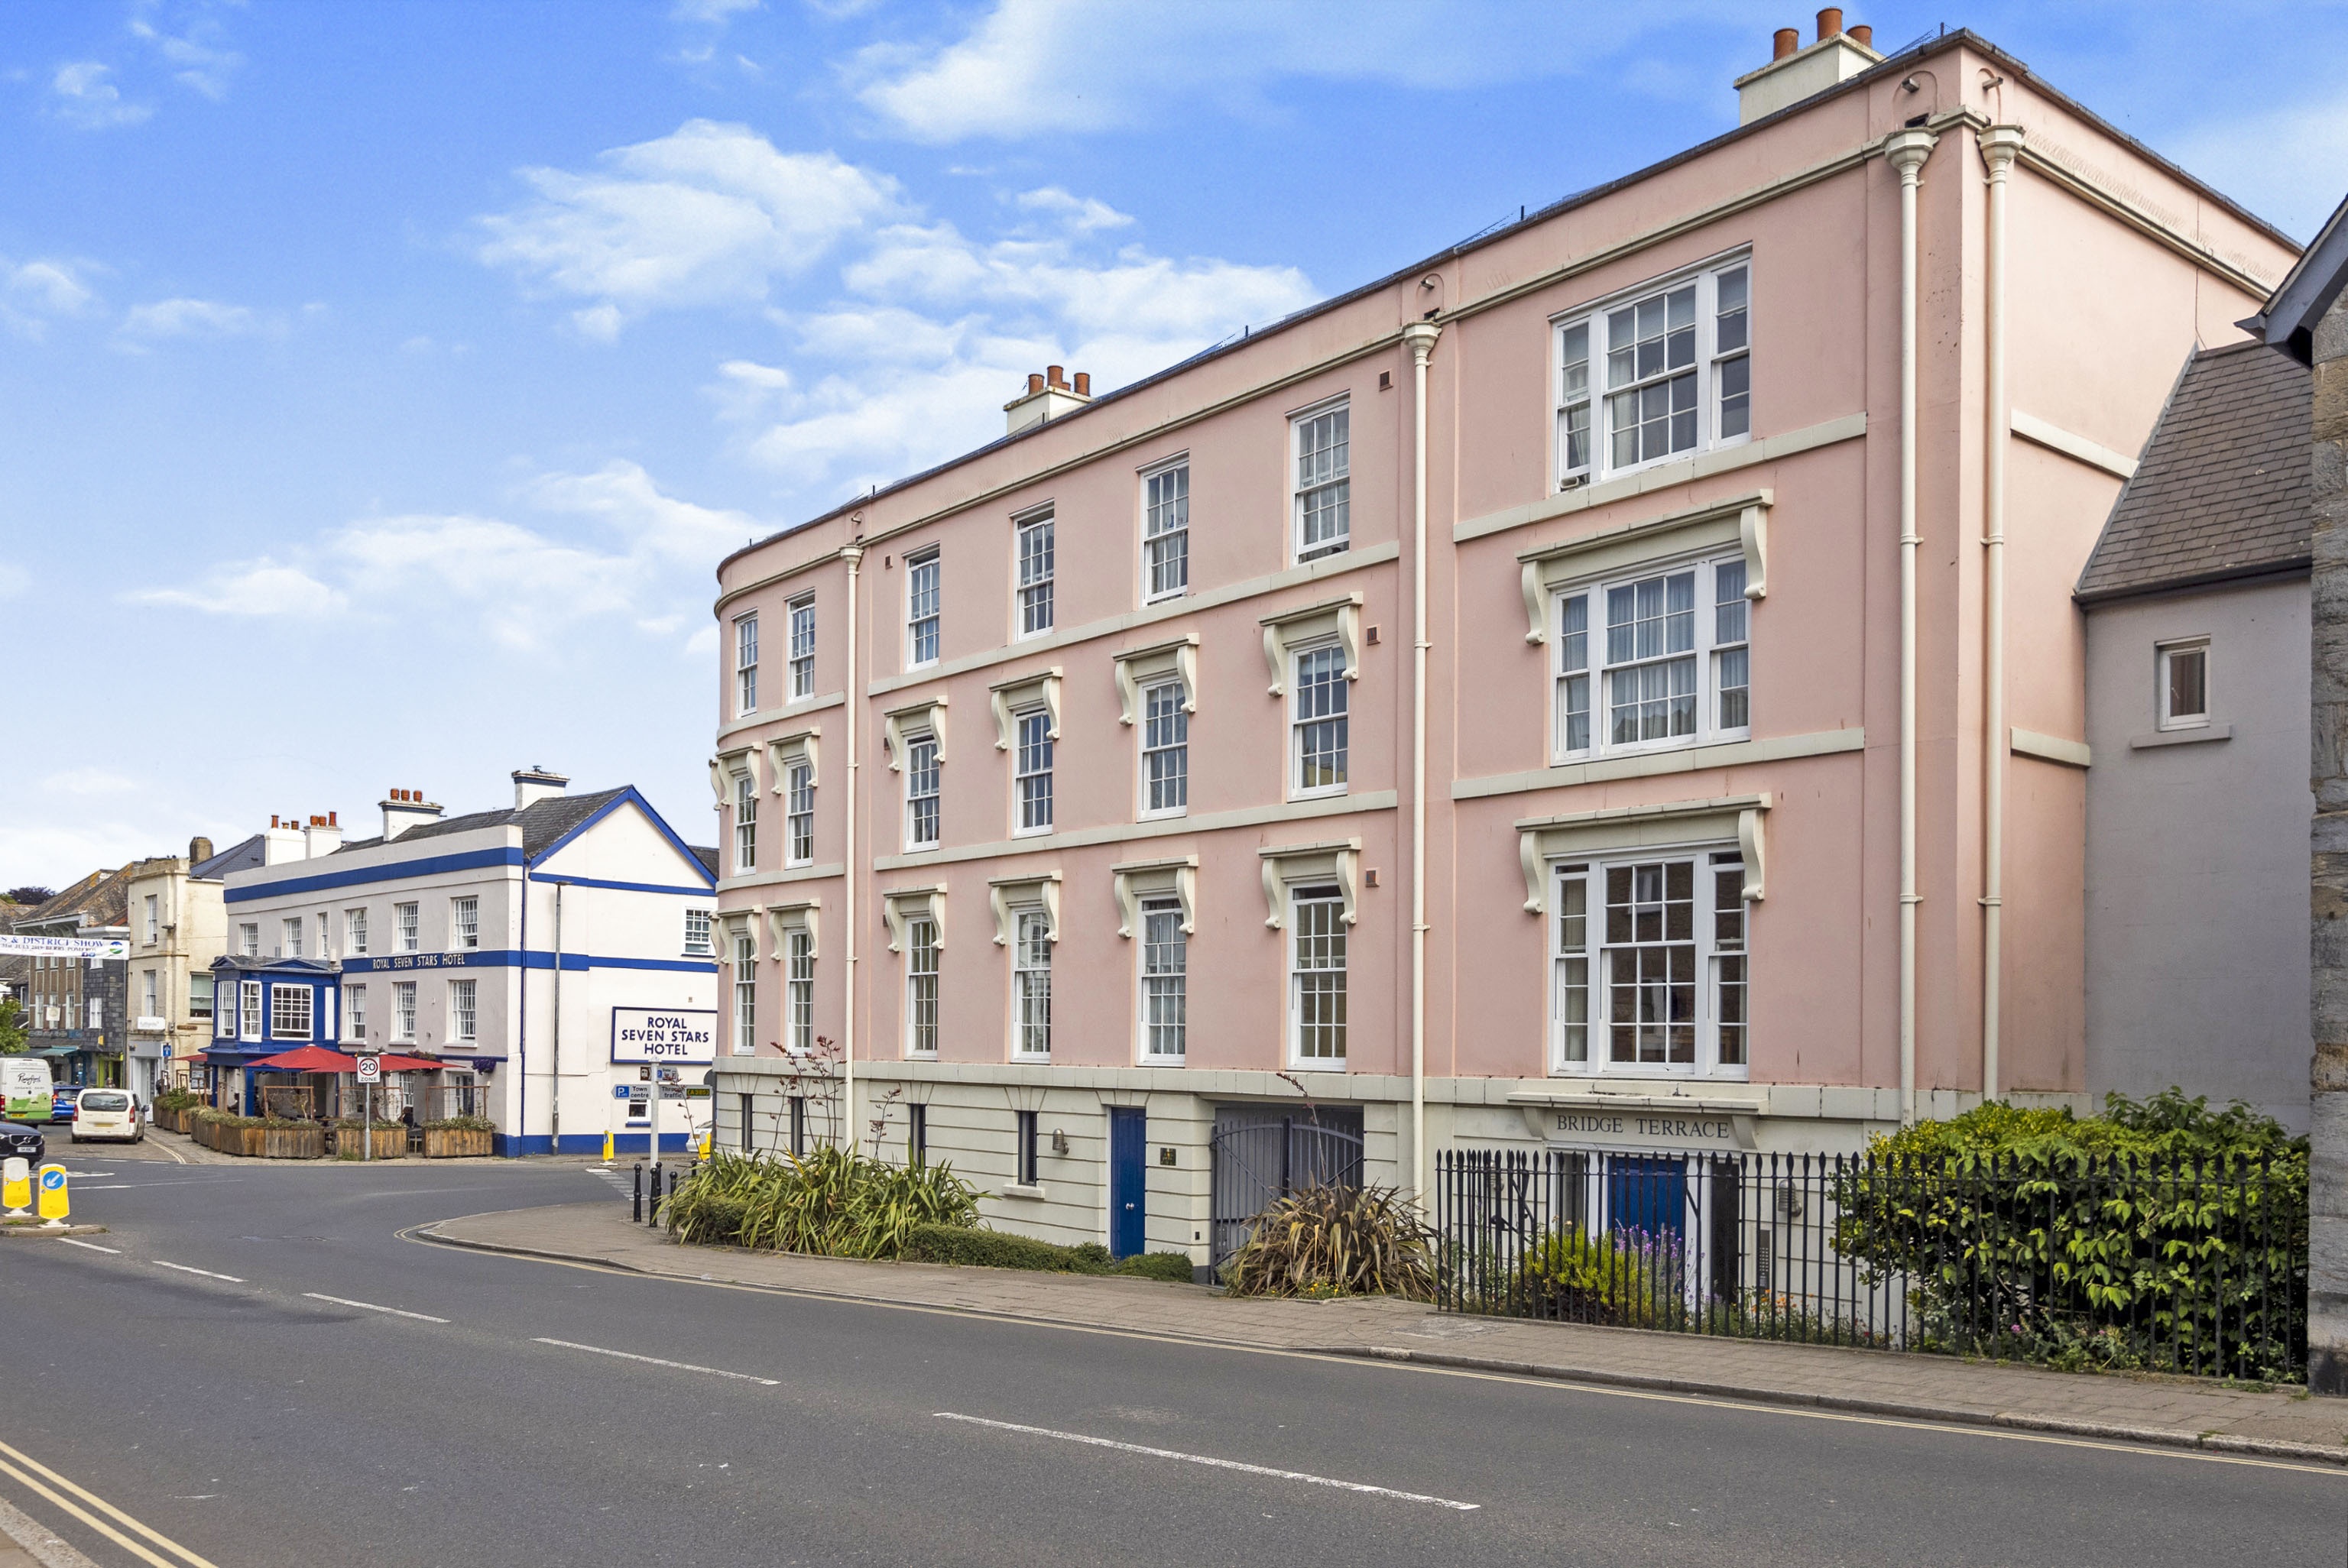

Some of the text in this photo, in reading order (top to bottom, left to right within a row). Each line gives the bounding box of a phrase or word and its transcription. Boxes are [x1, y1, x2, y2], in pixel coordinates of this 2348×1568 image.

[23, 937, 70, 946] DISTRICT
[373, 953, 465, 969] ROYAL SEVEN STARS HOTEL
[647, 1016, 687, 1029] ROYAL
[621, 1029, 709, 1042] SEVEN STARS
[644, 1043, 688, 1055] HOTEL
[618, 1087, 625, 1097] P
[1557, 1115, 1730, 1139] BRIDGE TERRACE
